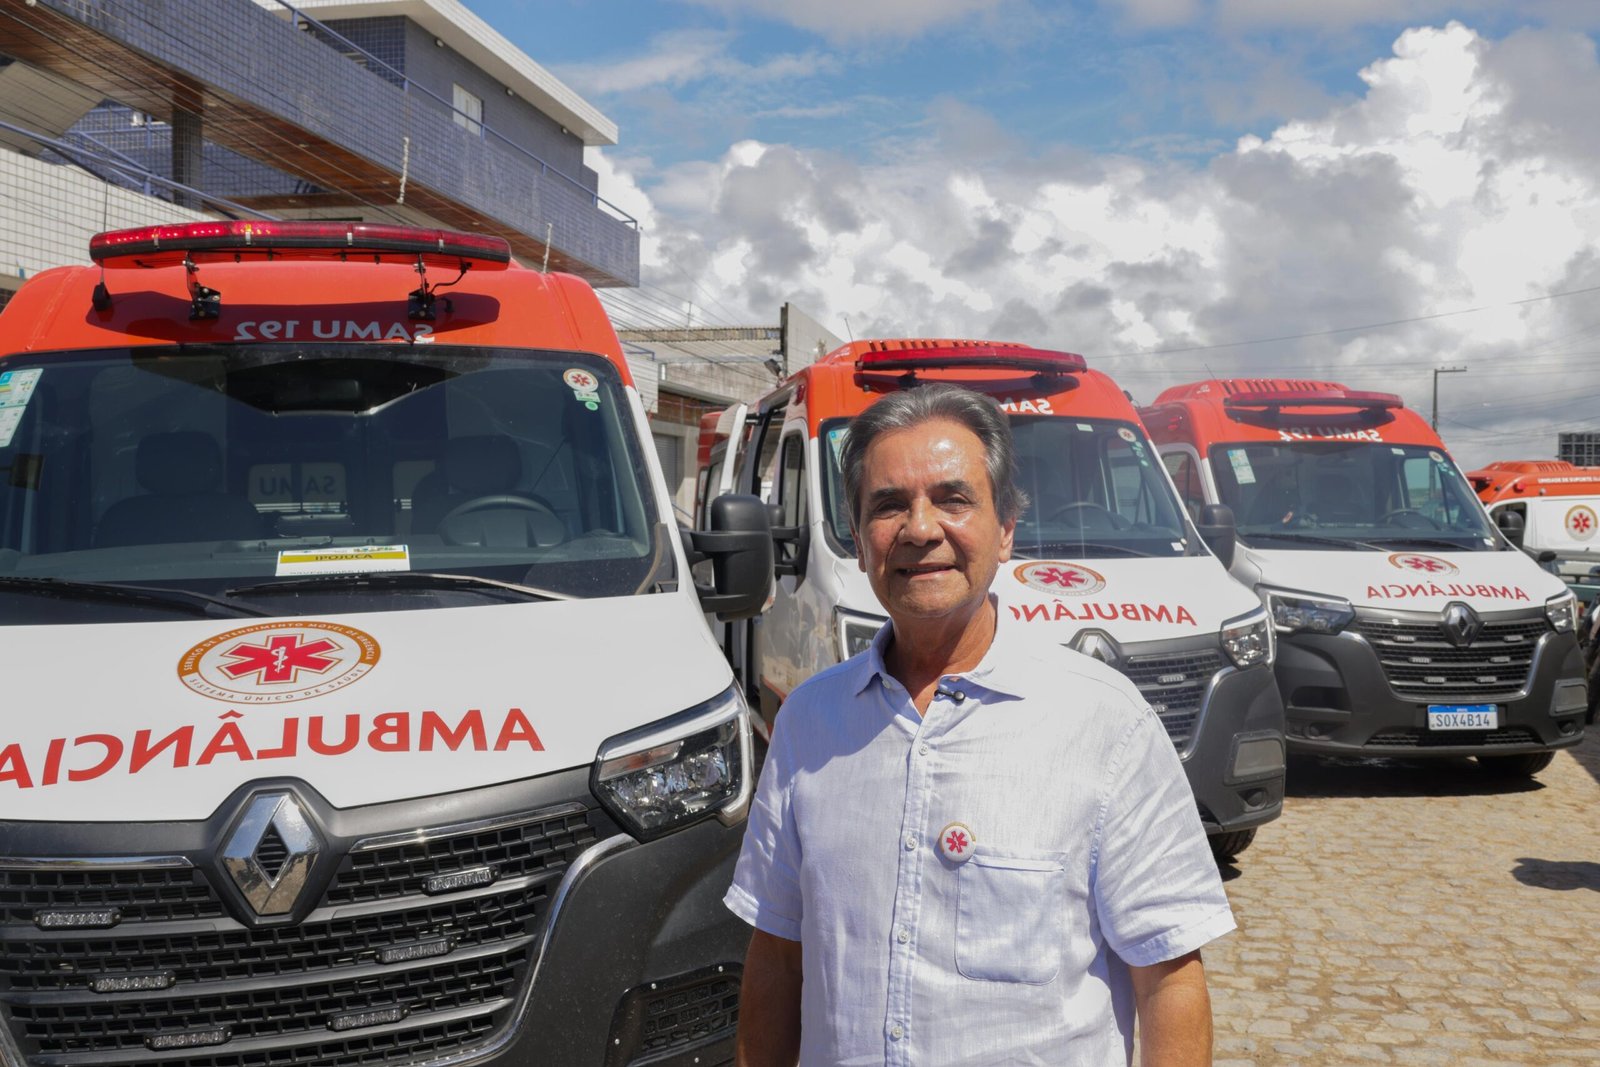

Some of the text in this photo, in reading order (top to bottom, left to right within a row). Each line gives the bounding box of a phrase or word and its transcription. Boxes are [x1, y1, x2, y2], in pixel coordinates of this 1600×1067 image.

[218, 623, 304, 640] ATENDIMENTO
[189, 678, 234, 699] SISTEMA
[1436, 714, 1490, 727] SOX4B14
